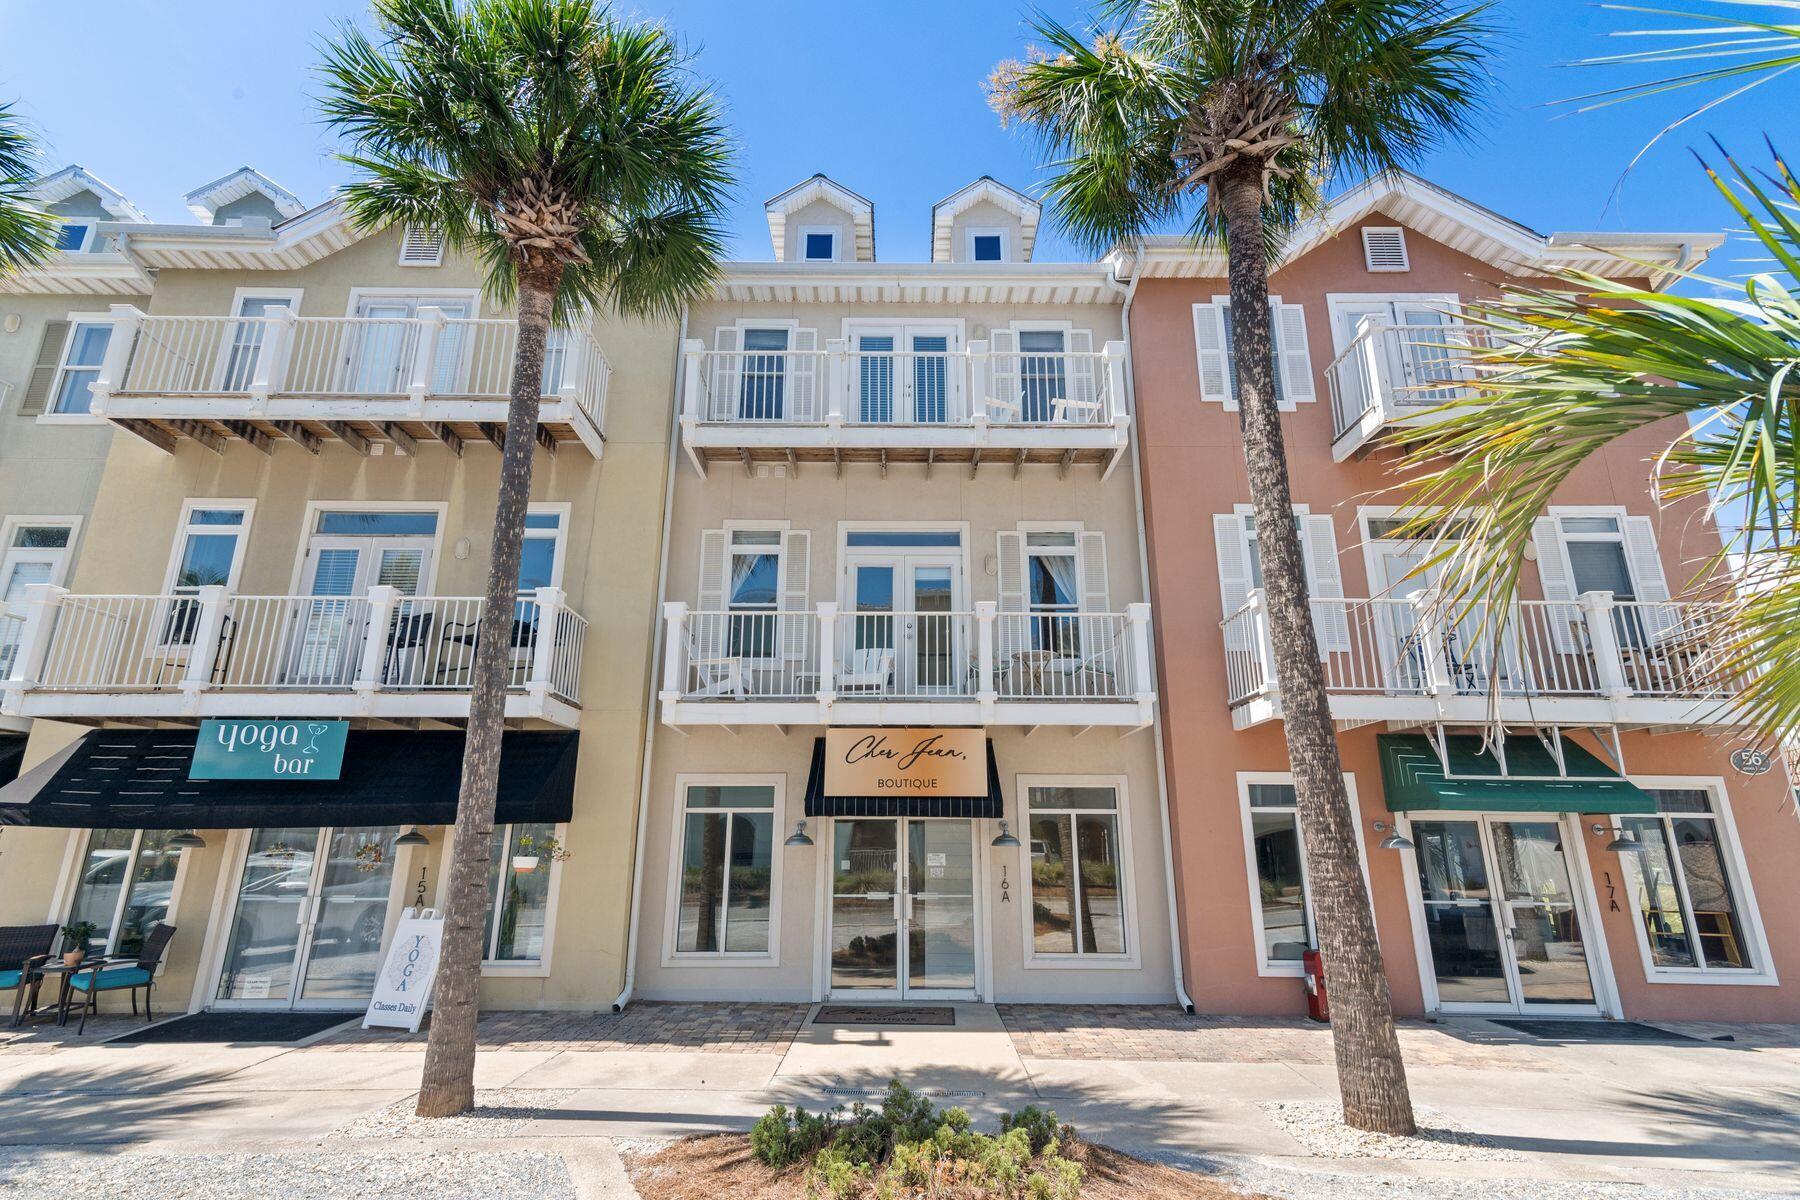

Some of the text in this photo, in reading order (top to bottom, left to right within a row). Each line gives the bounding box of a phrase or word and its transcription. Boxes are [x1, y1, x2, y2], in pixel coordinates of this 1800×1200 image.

[217, 723, 299, 753] yoga
[845, 734, 967, 771] Cher Jean,
[273, 753, 314, 774] bar
[1741, 752, 1762, 766] 56
[877, 778, 938, 790] BOUTIQUE
[414, 866, 427, 907] 15A
[1001, 865, 1011, 903] 16A
[1604, 871, 1621, 913] 17A
[395, 935, 425, 992] YOGA
[373, 1001, 417, 1015] Classes Daily
